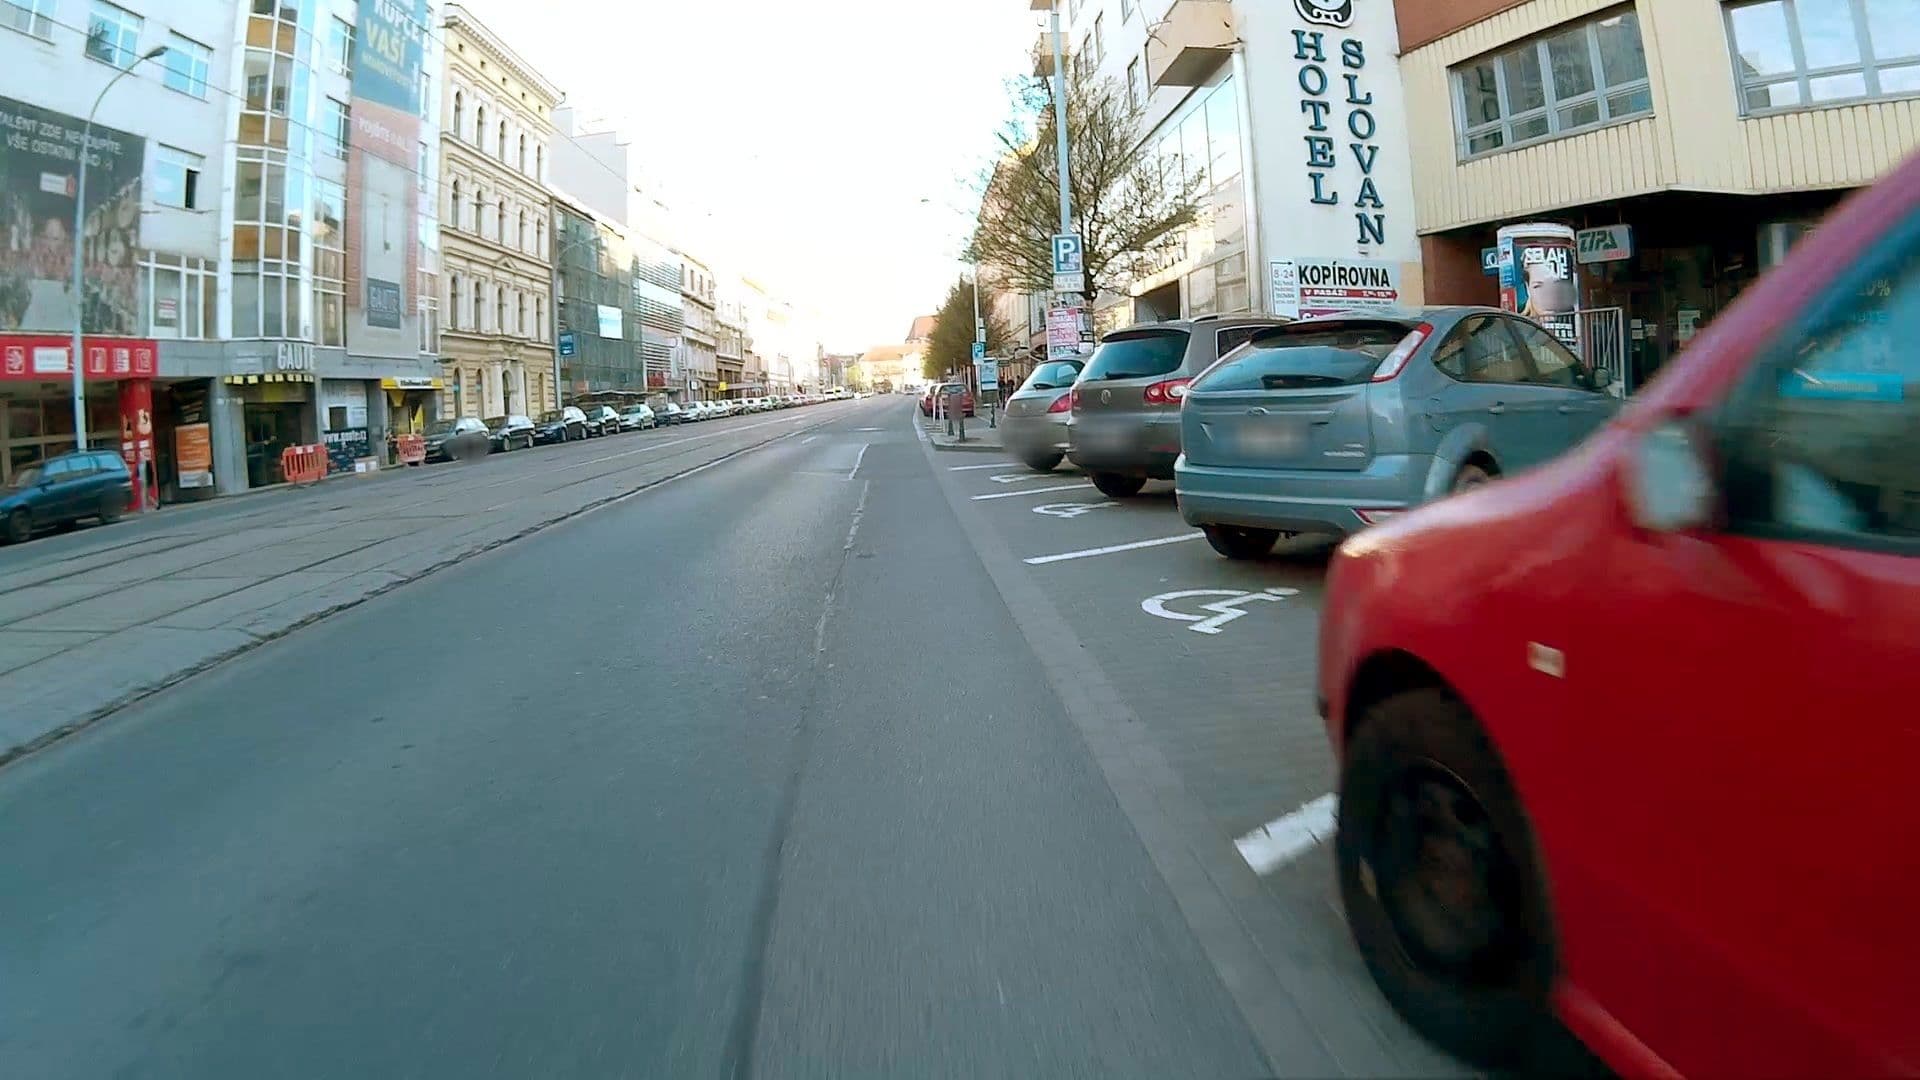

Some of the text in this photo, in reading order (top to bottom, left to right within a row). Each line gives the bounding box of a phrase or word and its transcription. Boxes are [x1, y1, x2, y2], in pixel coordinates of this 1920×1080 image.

[1291, 28, 1339, 205] HOTEL
[1341, 38, 1386, 245] SLOVAN
[1058, 239, 1076, 262] P
[1298, 261, 1391, 287] KOPÍROVNA
[278, 343, 319, 370] GAUTE
